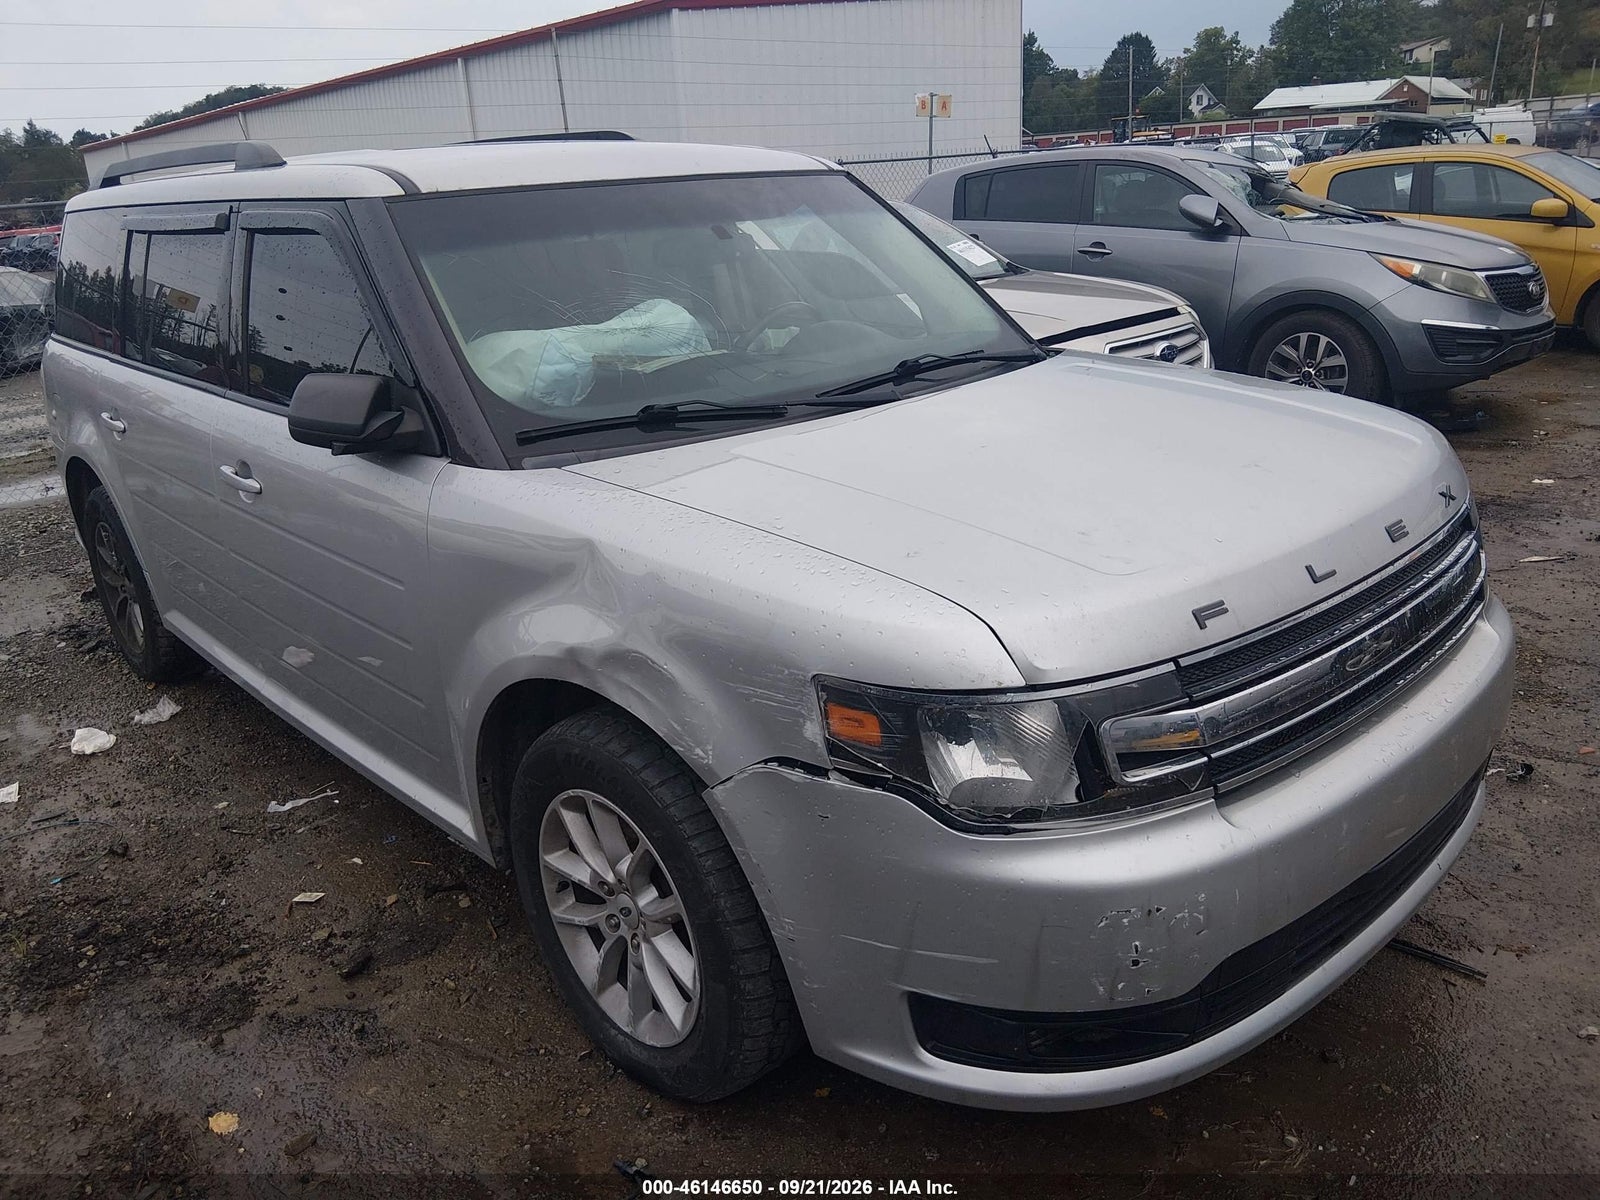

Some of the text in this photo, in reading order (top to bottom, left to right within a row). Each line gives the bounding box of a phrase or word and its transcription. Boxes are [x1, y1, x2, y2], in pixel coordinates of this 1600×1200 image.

[921, 99, 927, 110] B
[941, 100, 948, 111] A
[1191, 485, 1457, 630] FLEX
